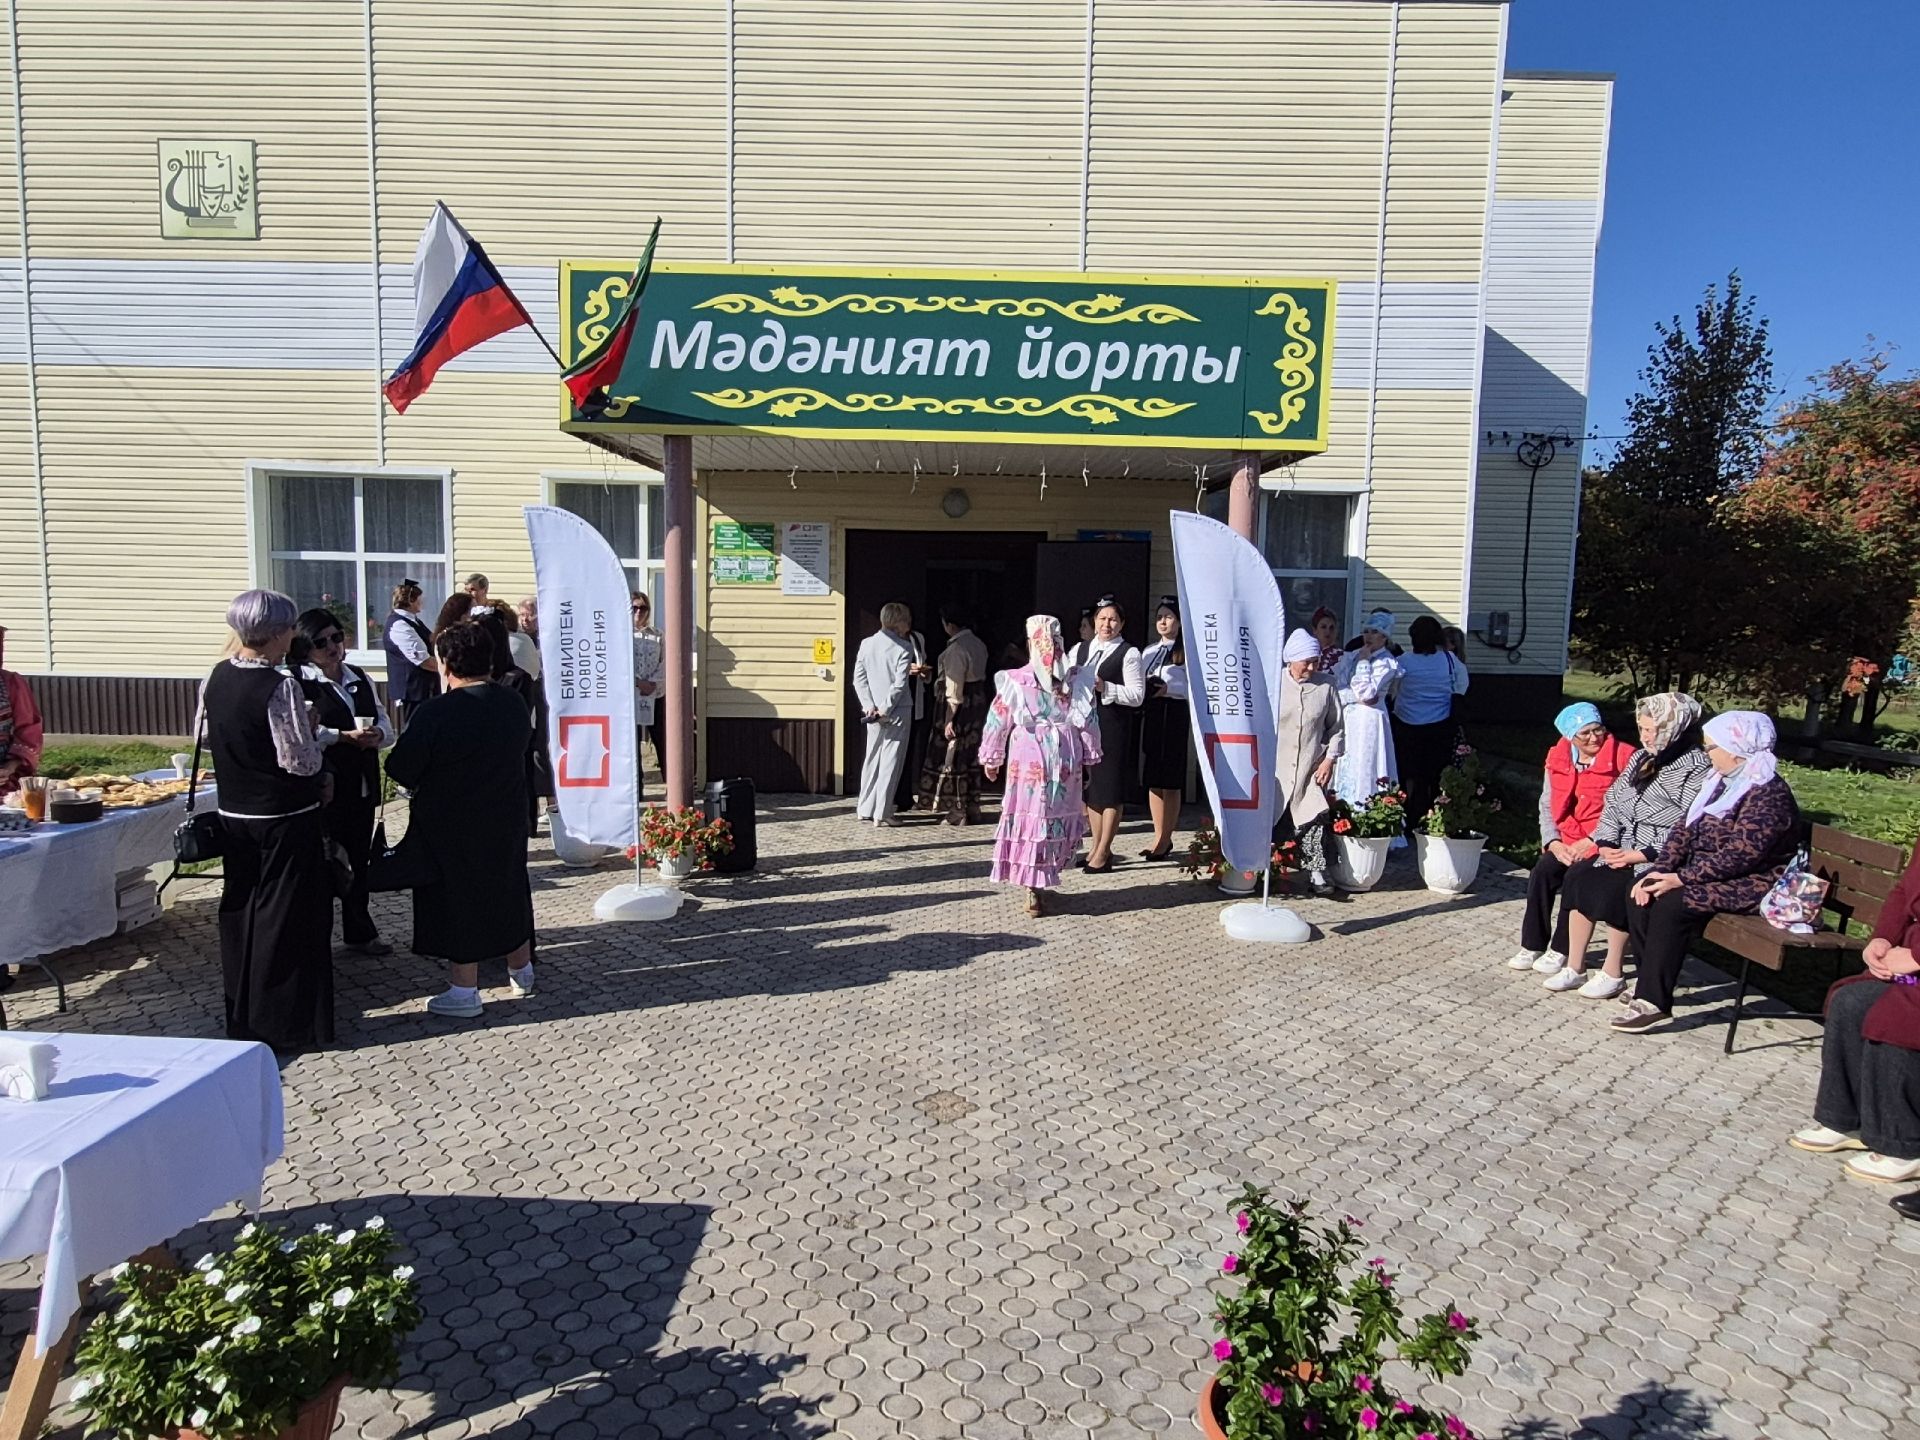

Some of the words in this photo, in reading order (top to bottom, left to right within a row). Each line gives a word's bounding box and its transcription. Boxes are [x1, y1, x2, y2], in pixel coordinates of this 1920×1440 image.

[649, 319, 991, 377] Мәдәният
[1017, 325, 1242, 393] йорты
[560, 600, 575, 699] БИБЛИОТЕКА
[578, 638, 592, 699] НОВОГО
[593, 610, 608, 699] ПОКОЛЕНИЯ
[1204, 613, 1220, 716] БИБЛИОТЕКА
[1224, 653, 1239, 716] НОВОГО
[1239, 626, 1253, 717] ПОКОЛЕНИЯ
